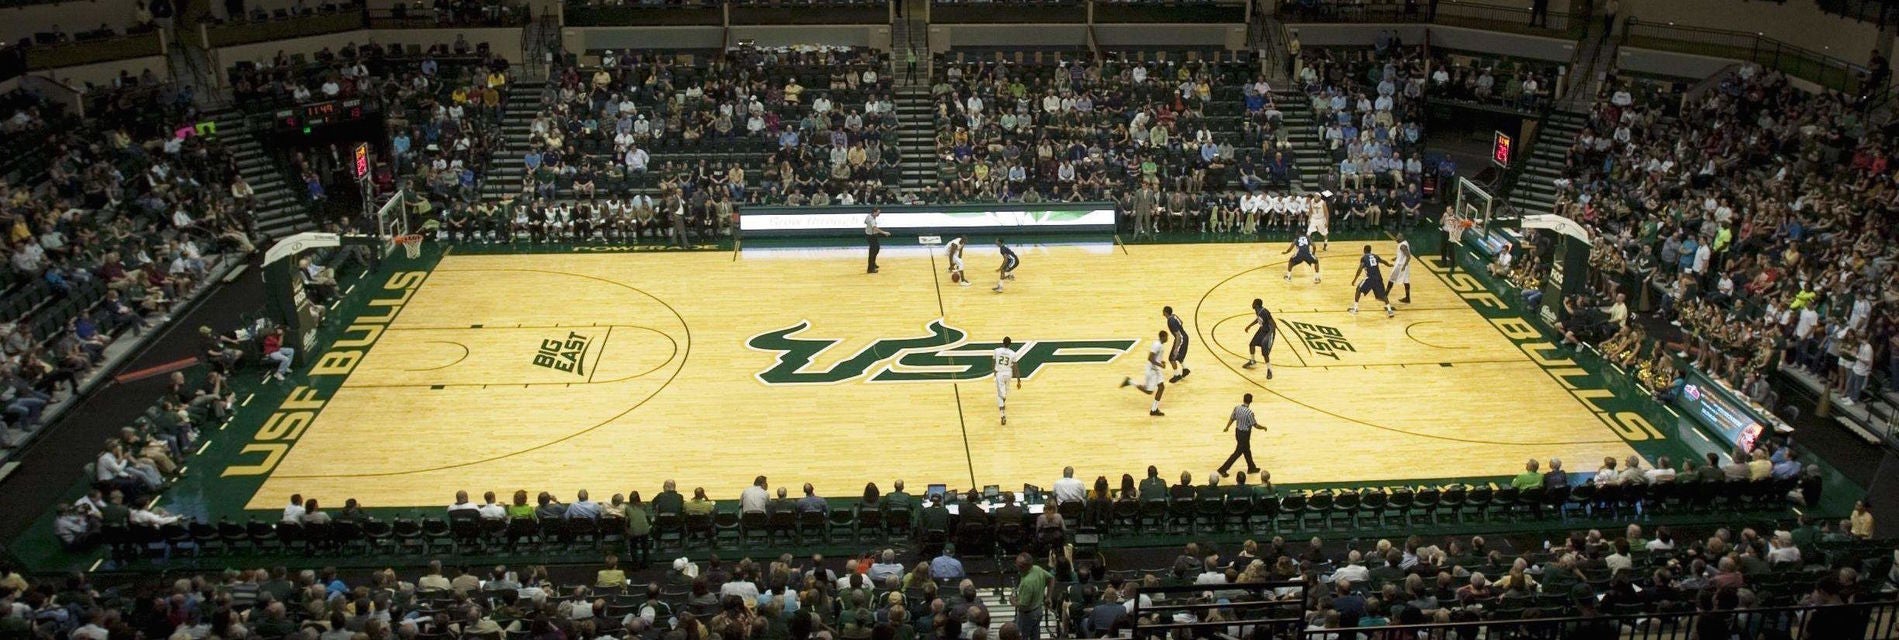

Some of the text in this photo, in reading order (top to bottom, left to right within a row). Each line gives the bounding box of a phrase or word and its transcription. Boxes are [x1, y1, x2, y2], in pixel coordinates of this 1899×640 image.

[532, 338, 563, 369] BIG
[554, 331, 587, 373] EAST
[745, 317, 1141, 386] USF
[1292, 321, 1341, 361] EAST
[1315, 324, 1357, 353] BIG
[1418, 255, 1509, 310] USF
[1489, 317, 1666, 442] BULLS
[220, 270, 429, 478] USF BULLS
[998, 355, 1010, 366] 23
